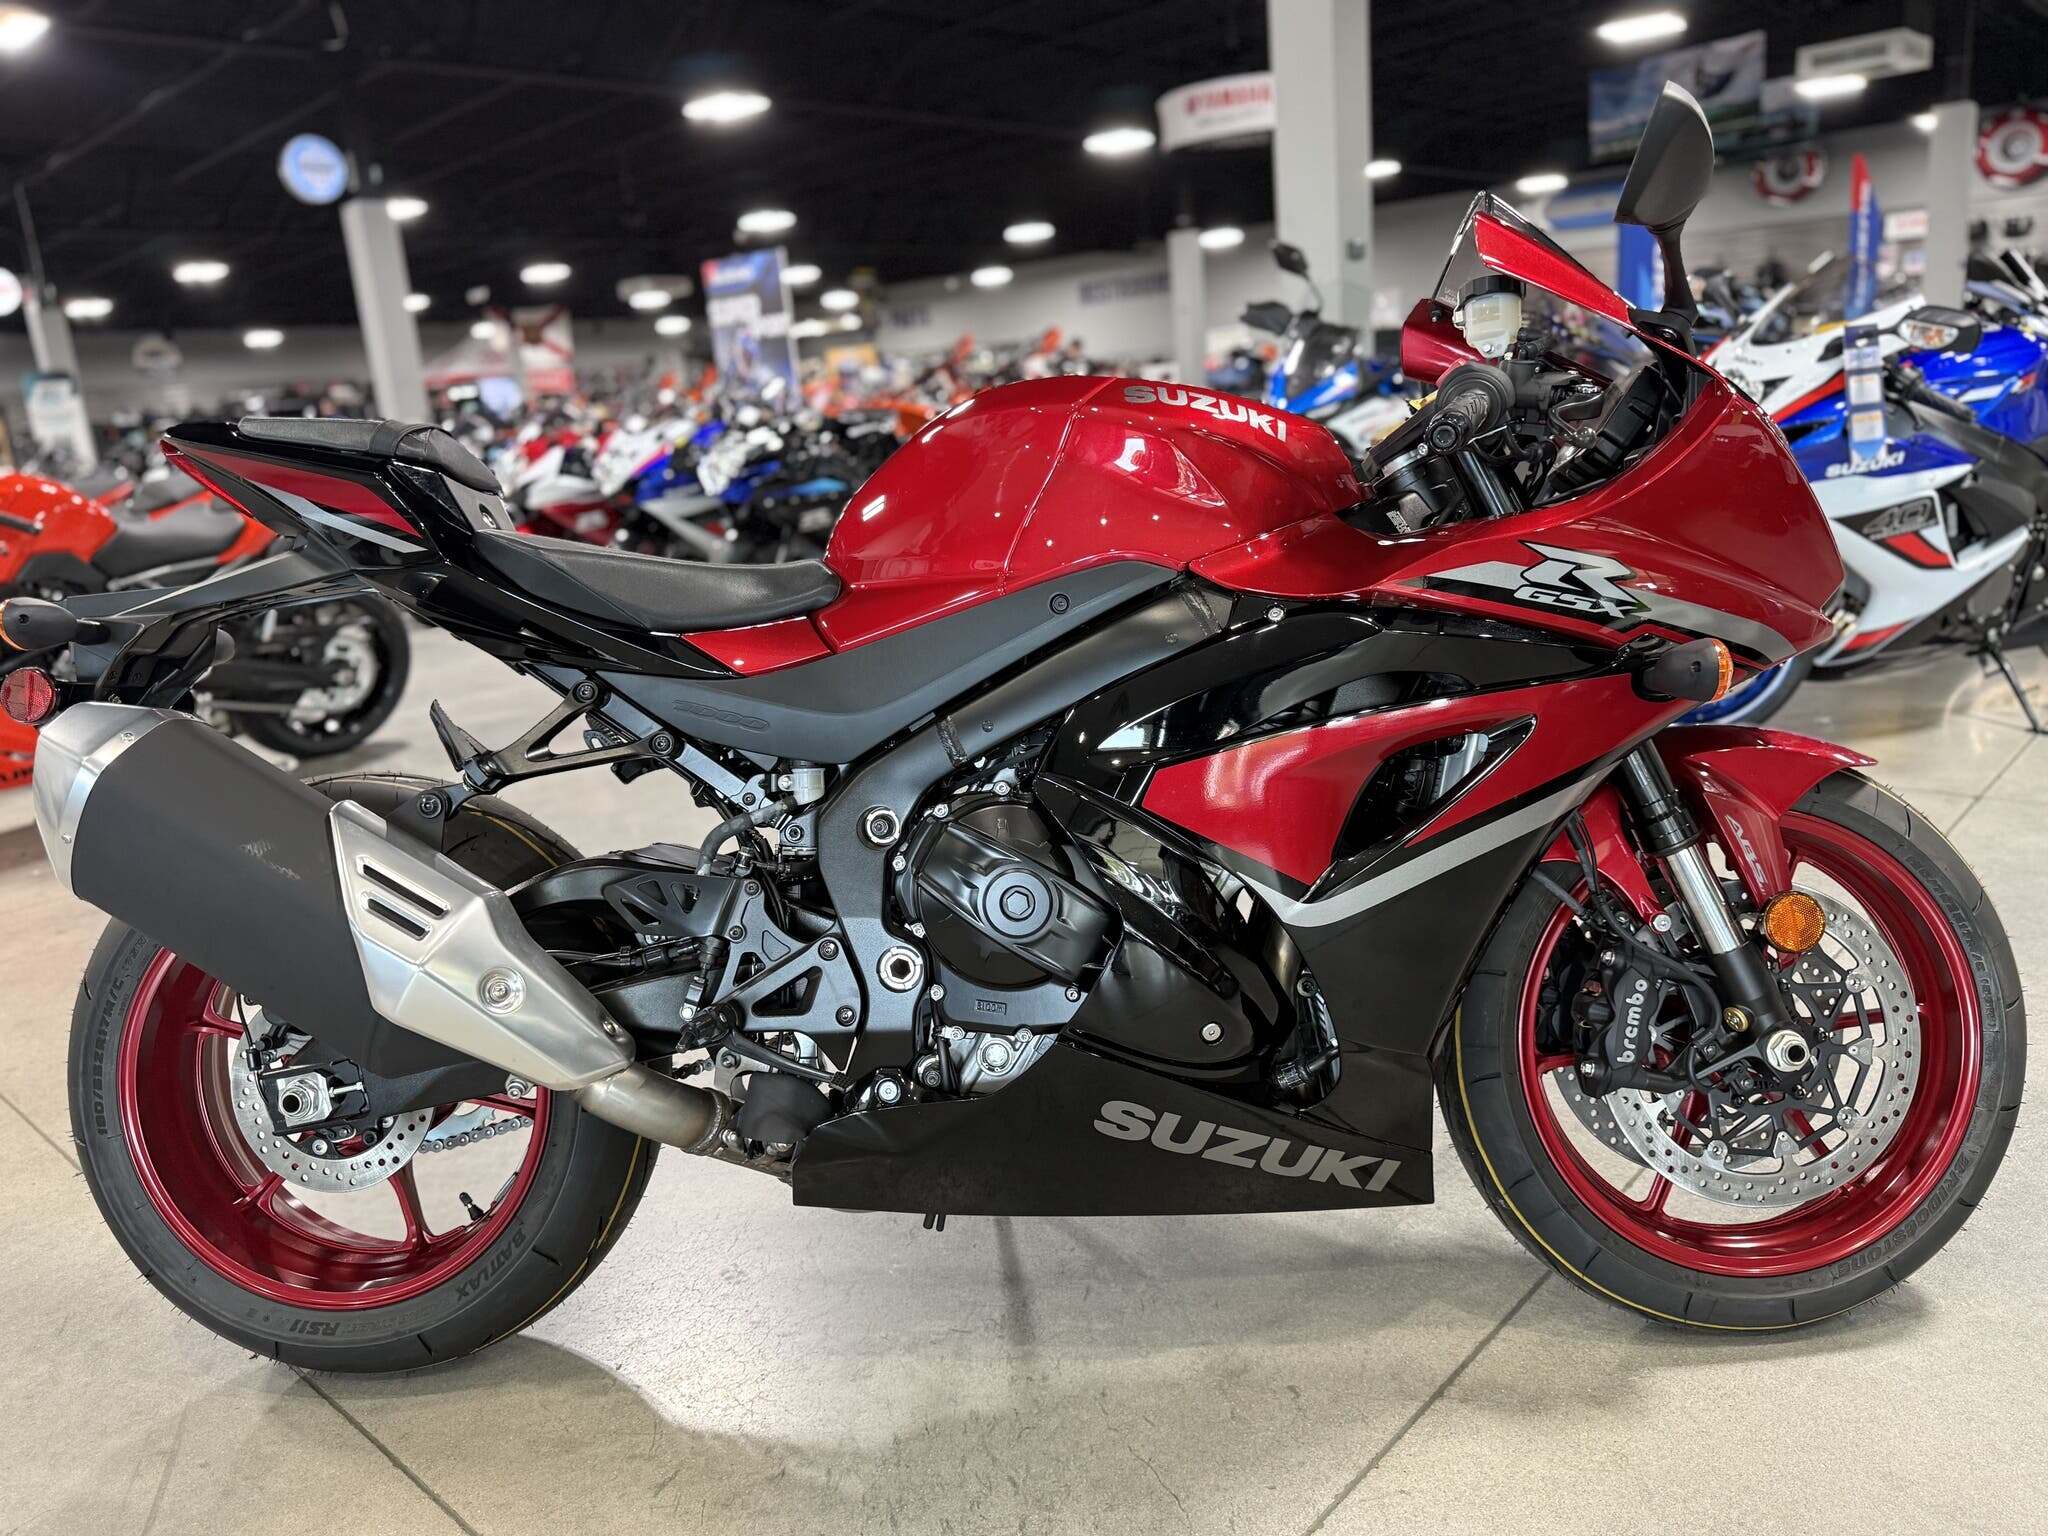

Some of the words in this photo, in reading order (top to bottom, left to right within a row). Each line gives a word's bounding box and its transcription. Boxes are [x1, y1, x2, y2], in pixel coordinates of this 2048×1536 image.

[1123, 385, 1287, 443] SUZUKI
[1825, 450, 1905, 478] SUZUKI
[1513, 586, 1638, 619] GSX
[1725, 814, 1768, 896] ABS
[1616, 979, 1648, 1063] brembo
[1093, 1100, 1402, 1192] SUZUKI
[455, 1228, 529, 1303] BATTLAX
